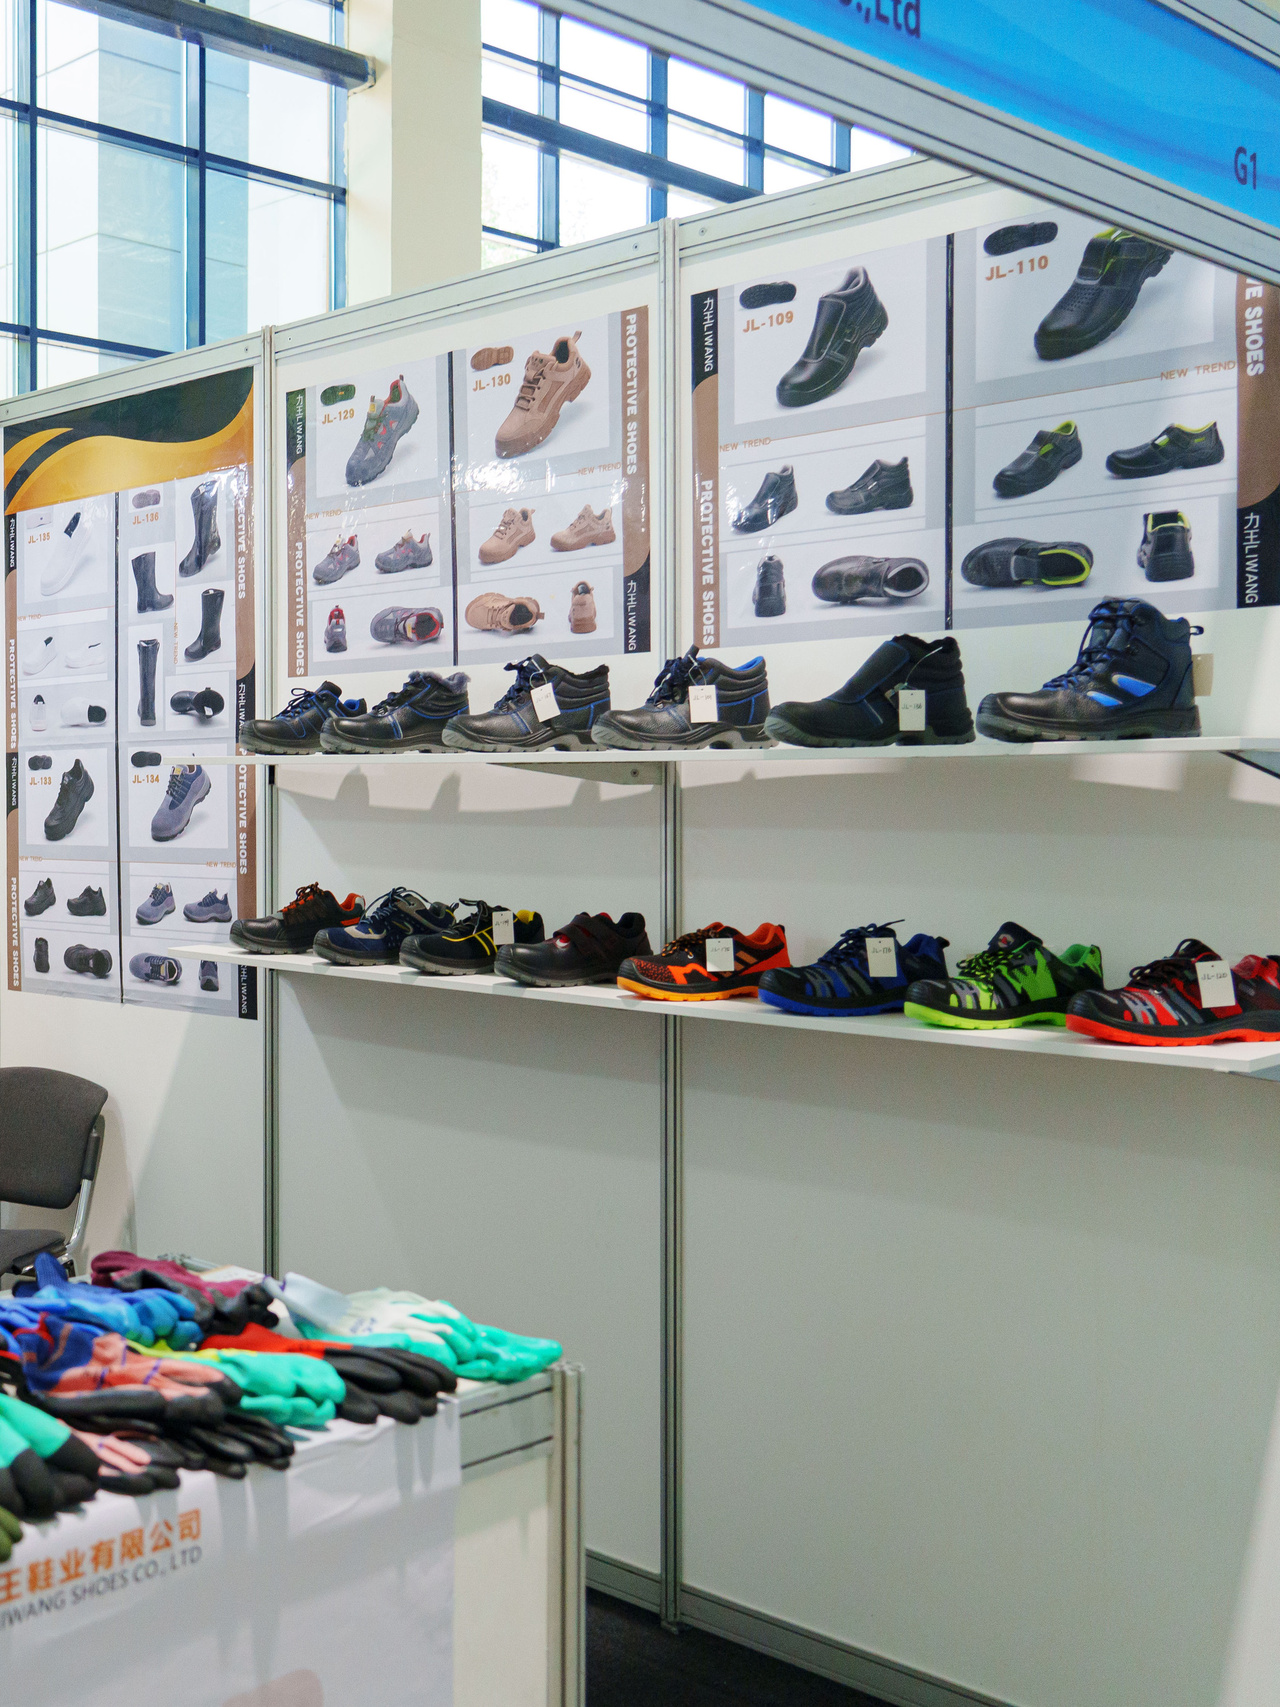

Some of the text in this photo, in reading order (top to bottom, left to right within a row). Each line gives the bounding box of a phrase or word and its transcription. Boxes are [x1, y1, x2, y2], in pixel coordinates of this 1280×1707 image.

[1233, 145, 1258, 191] G1
[985, 255, 1049, 282] JL-110
[742, 310, 795, 333] JL-109
[1245, 305, 1265, 377] SHOES
[472, 373, 512, 393] JL-130
[1160, 360, 1236, 382] NEW TREND
[625, 313, 638, 476] PROTECTIVE SHOES
[321, 408, 356, 425] JL-129
[720, 436, 771, 453] NEW TREND
[578, 462, 622, 476] NEW TREND
[132, 511, 160, 526] JL-136
[27, 531, 52, 545] JL-135
[701, 479, 716, 647] PROTECTIVE SHOES
[237, 556, 247, 600] SHOES
[294, 541, 304, 677] PROTECTIVE SHOES
[9, 638, 17, 712] PROTECTIVE
[28, 776, 53, 787] JL-133
[132, 773, 160, 785] JL-134
[238, 747, 248, 875] POTECTIVE SHOES
[10, 877, 19, 987] PROTECTIVE SHOES
[72, 1568, 129, 1605] SHOES
[170, 1545, 203, 1571] LTD
